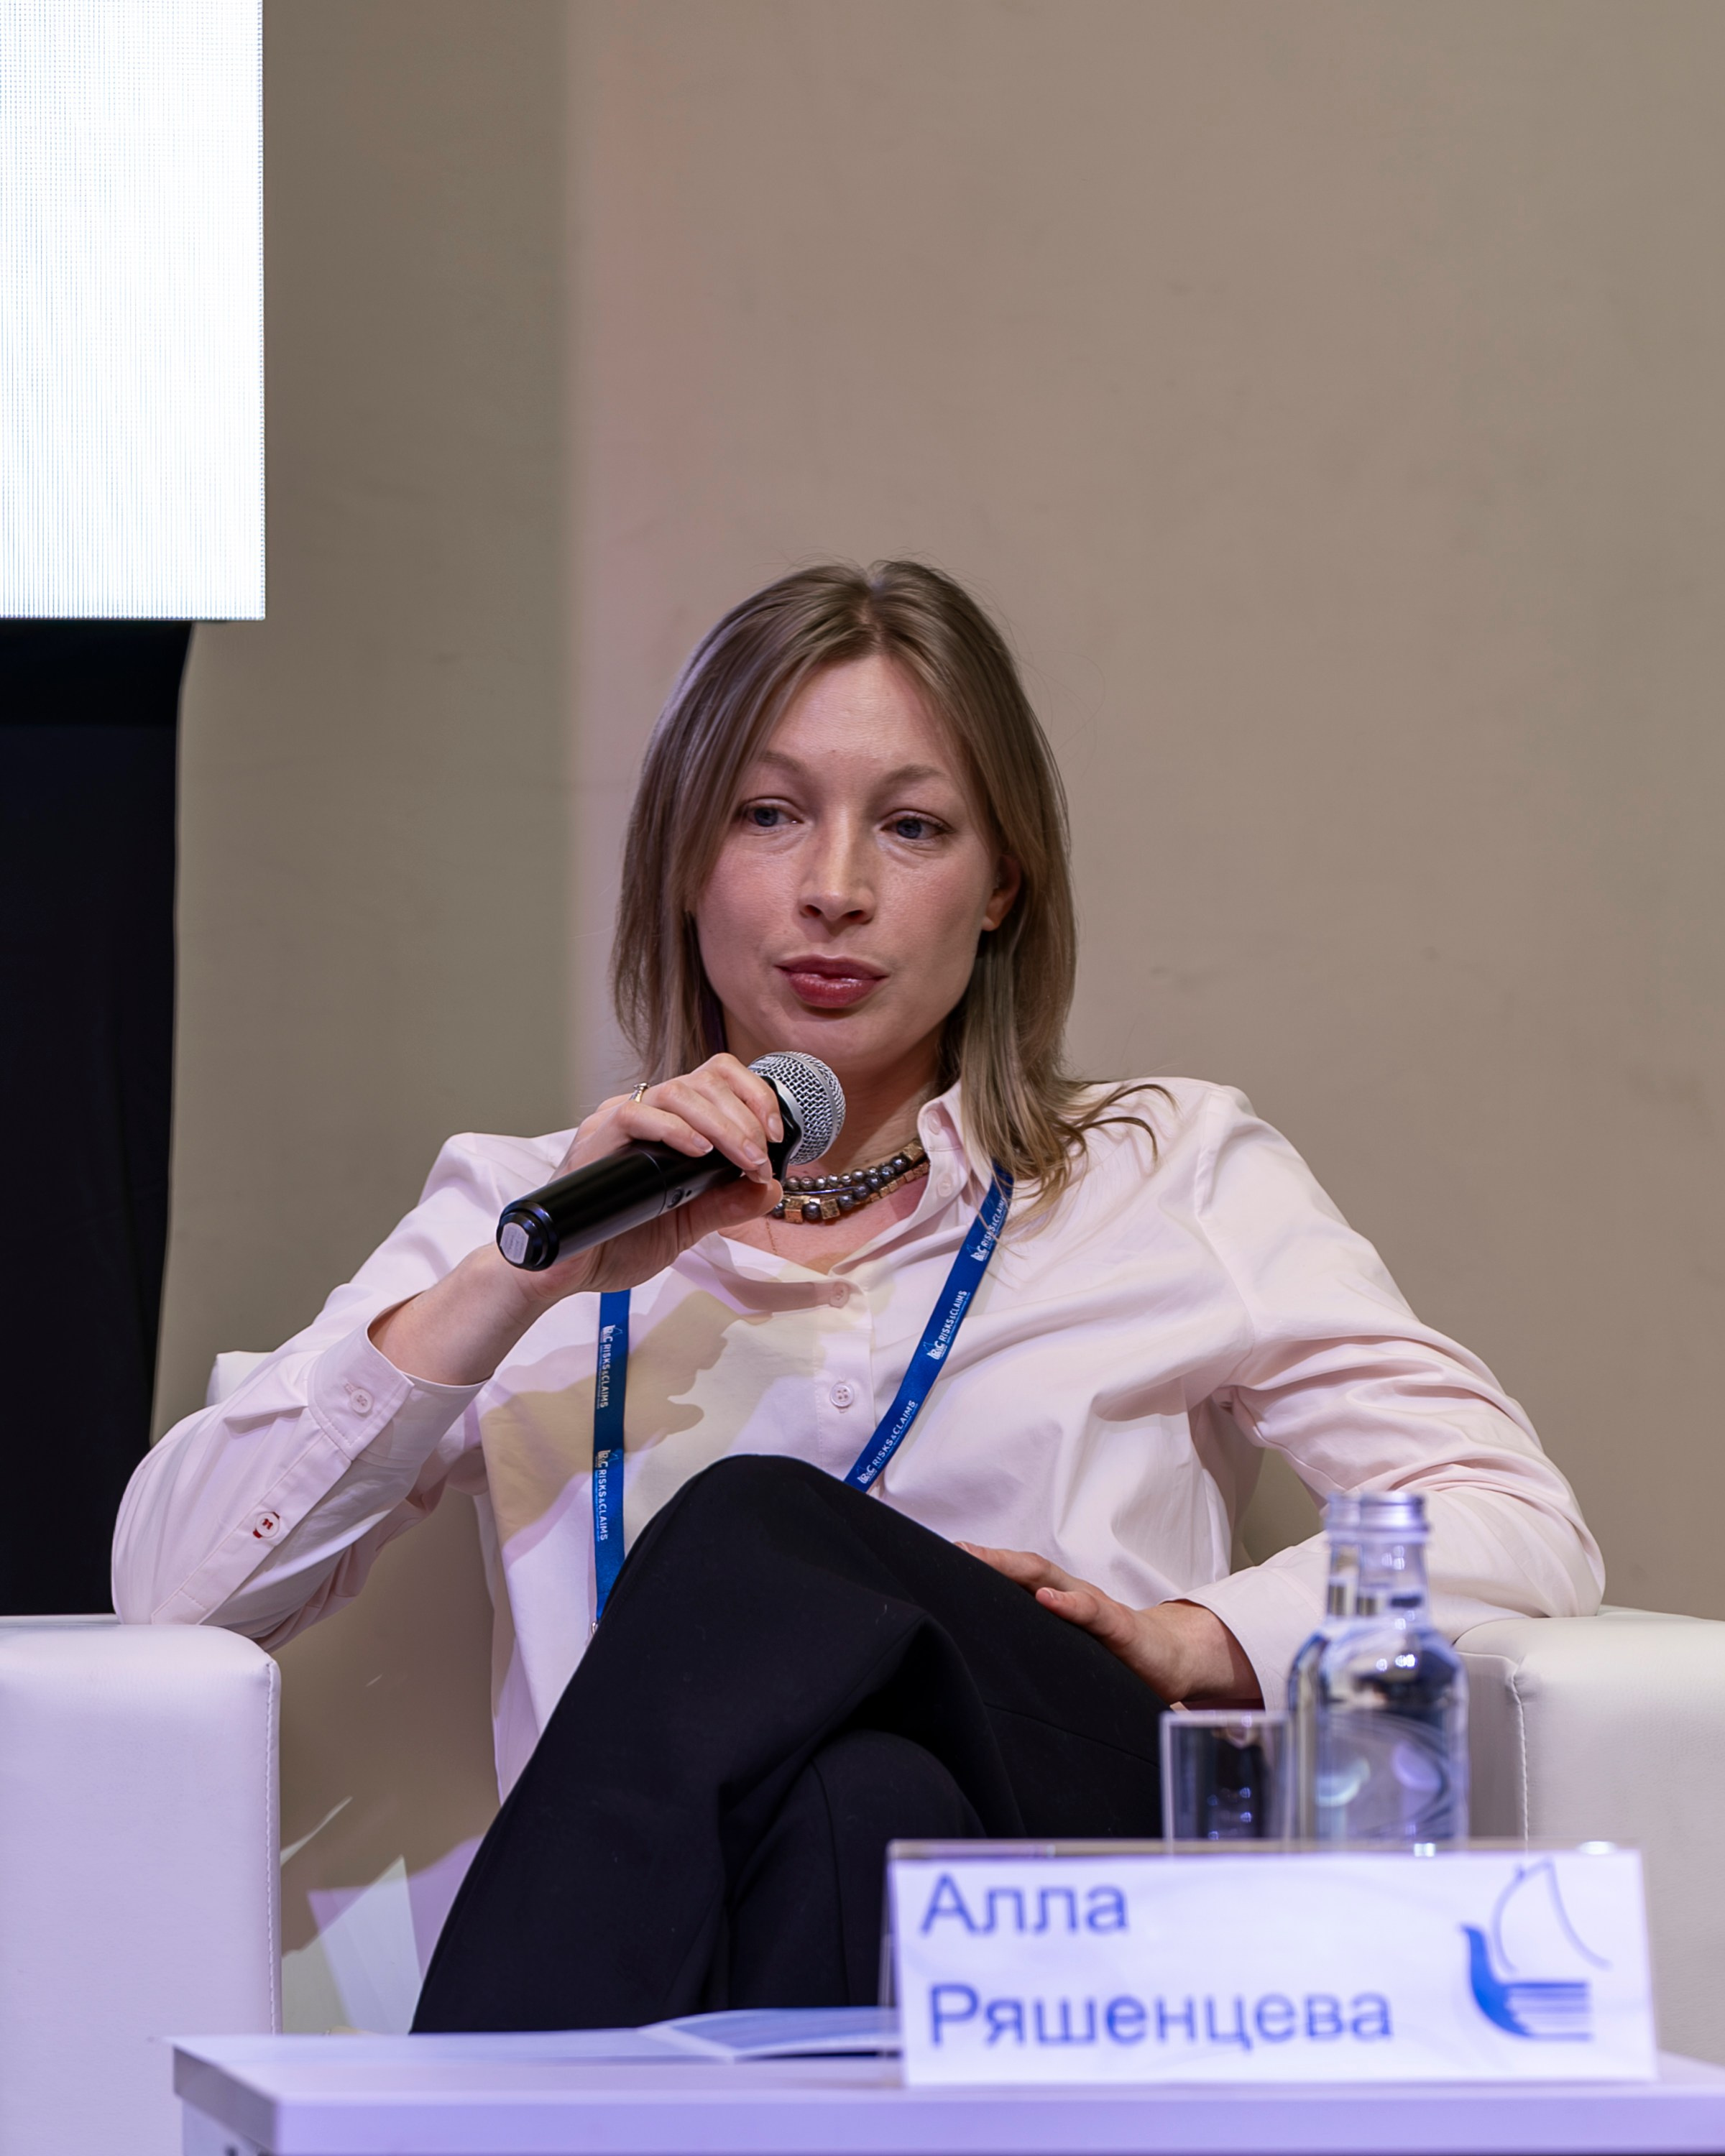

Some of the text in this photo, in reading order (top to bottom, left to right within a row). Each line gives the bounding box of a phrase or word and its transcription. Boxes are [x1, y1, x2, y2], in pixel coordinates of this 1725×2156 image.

[872, 1400, 916, 1466] RISKS&CLAIMS
[598, 1470, 608, 1541] RISKS&CLAIMS
[921, 1873, 1129, 1935] Алла
[929, 1985, 1393, 2053] Ряшенцева
